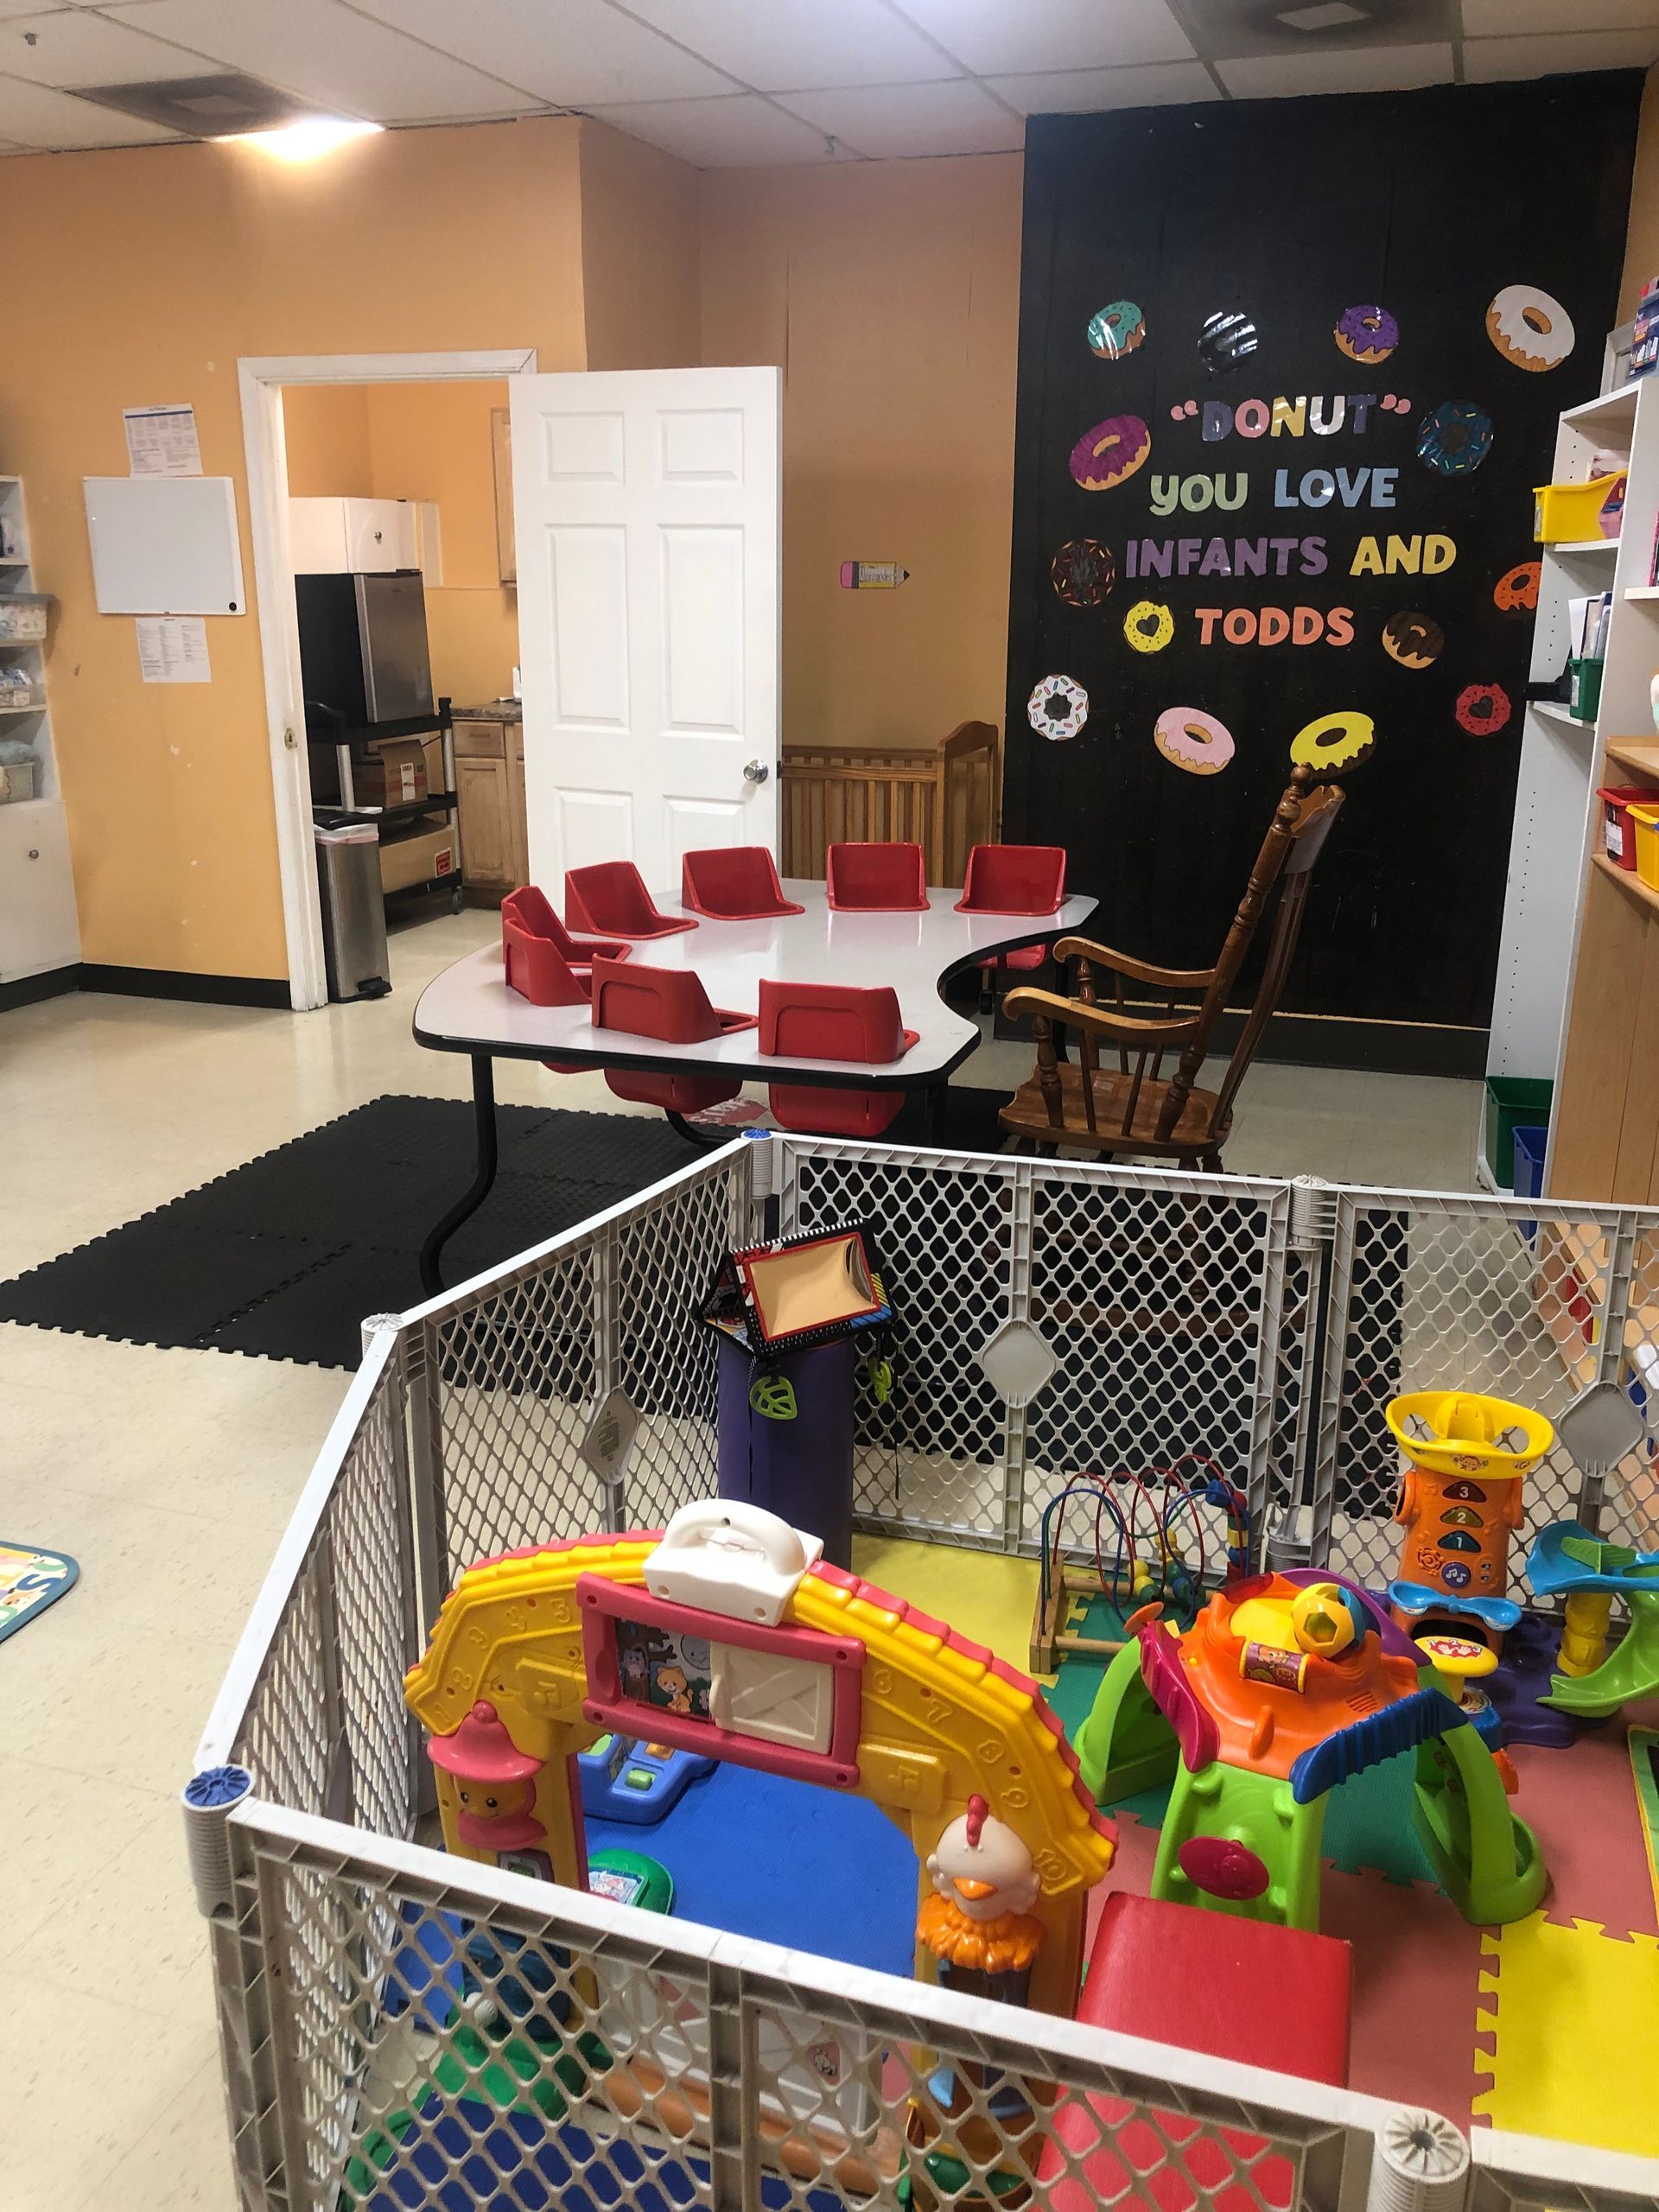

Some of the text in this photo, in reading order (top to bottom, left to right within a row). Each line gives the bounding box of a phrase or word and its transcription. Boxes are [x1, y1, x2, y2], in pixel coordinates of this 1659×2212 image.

[1274, 467, 1400, 508] LOVE
[1125, 534, 1457, 578] INFANTS AND
[1194, 607, 1355, 646] TODDS
[1459, 1486, 1469, 1499] 3
[1457, 1511, 1467, 1524] 2
[1456, 1536, 1463, 1549] 1
[550, 1599, 573, 1624] 5
[873, 1669, 893, 1694] 6
[927, 1697, 953, 1723] 7
[976, 1739, 1005, 1764] 8
[1000, 1788, 1029, 1808] 9
[1036, 1848, 1067, 1881] 10
